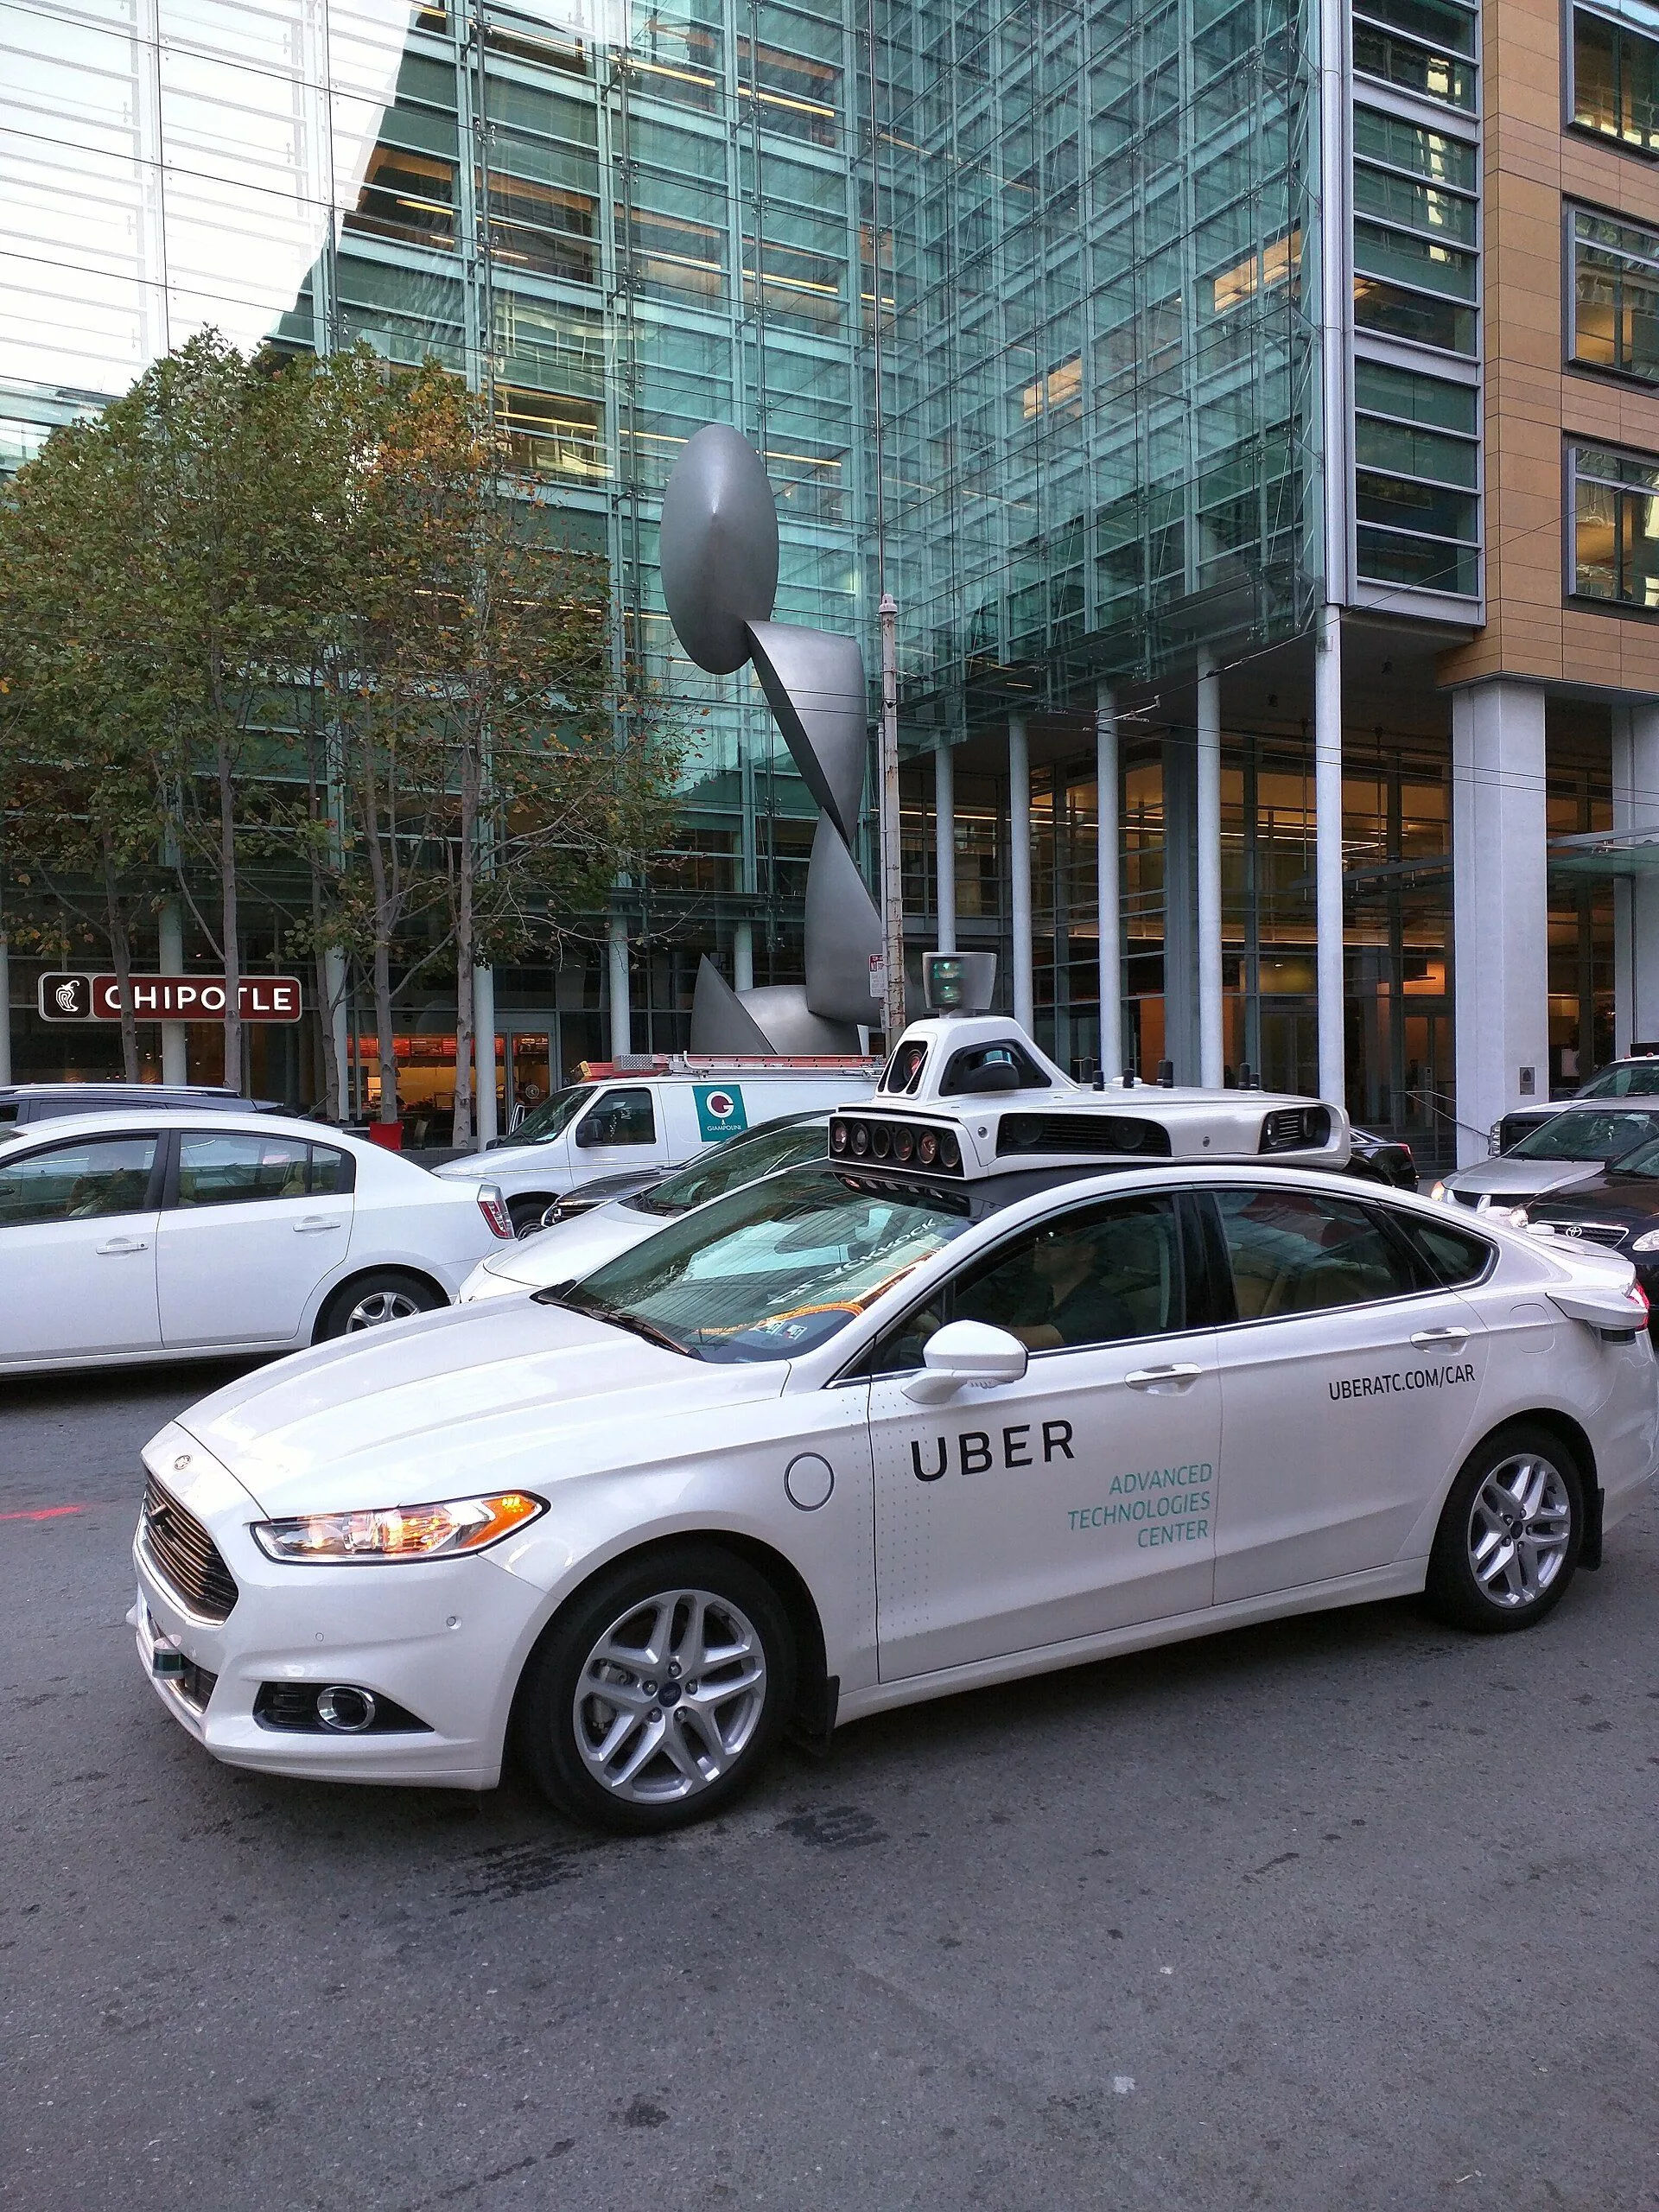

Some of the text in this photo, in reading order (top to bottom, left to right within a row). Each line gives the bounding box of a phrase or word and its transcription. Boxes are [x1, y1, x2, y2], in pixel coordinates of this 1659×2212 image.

[1329, 1363, 1476, 1401] UBERATC.COM/CAR
[911, 1420, 1075, 1482] UBER
[1109, 1463, 1212, 1495] ADVANCED
[1067, 1491, 1211, 1530] TECHNOLOGIES
[1137, 1519, 1209, 1548] CENTER
